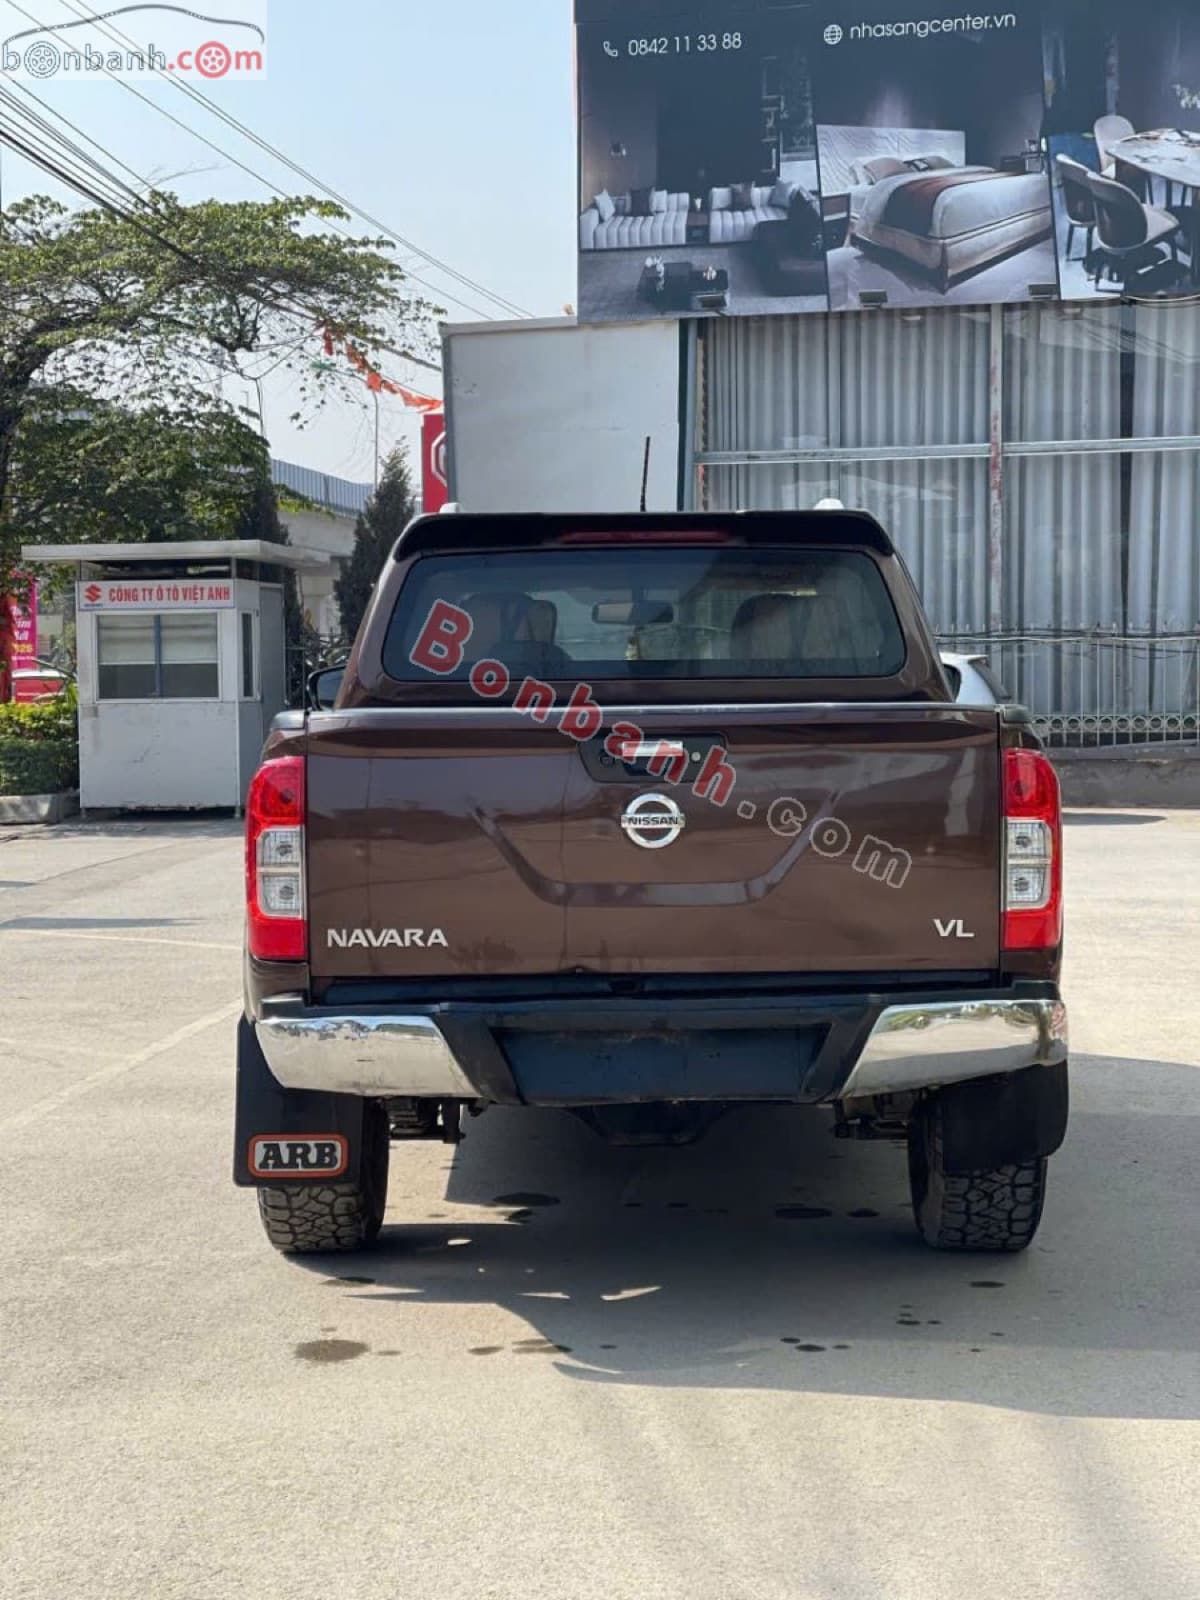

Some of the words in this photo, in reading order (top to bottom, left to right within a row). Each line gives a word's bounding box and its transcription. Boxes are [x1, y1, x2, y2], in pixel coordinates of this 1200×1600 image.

[850, 13, 1016, 38] nhasangcenter.vn
[628, 38, 668, 56] 0842
[674, 35, 690, 53] 11
[697, 33, 717, 51] 33
[722, 31, 742, 50] 88
[109, 584, 138, 602] CÔNG
[142, 586, 153, 602] TY
[156, 583, 164, 602] Ô
[167, 583, 179, 602] TÔ
[182, 584, 205, 604] VIỆT
[207, 585, 230, 601] ANH
[627, 816, 679, 825] NISSAN
[327, 928, 449, 948] NAVARA
[932, 918, 975, 937] VL
[259, 1143, 338, 1169] ARB
